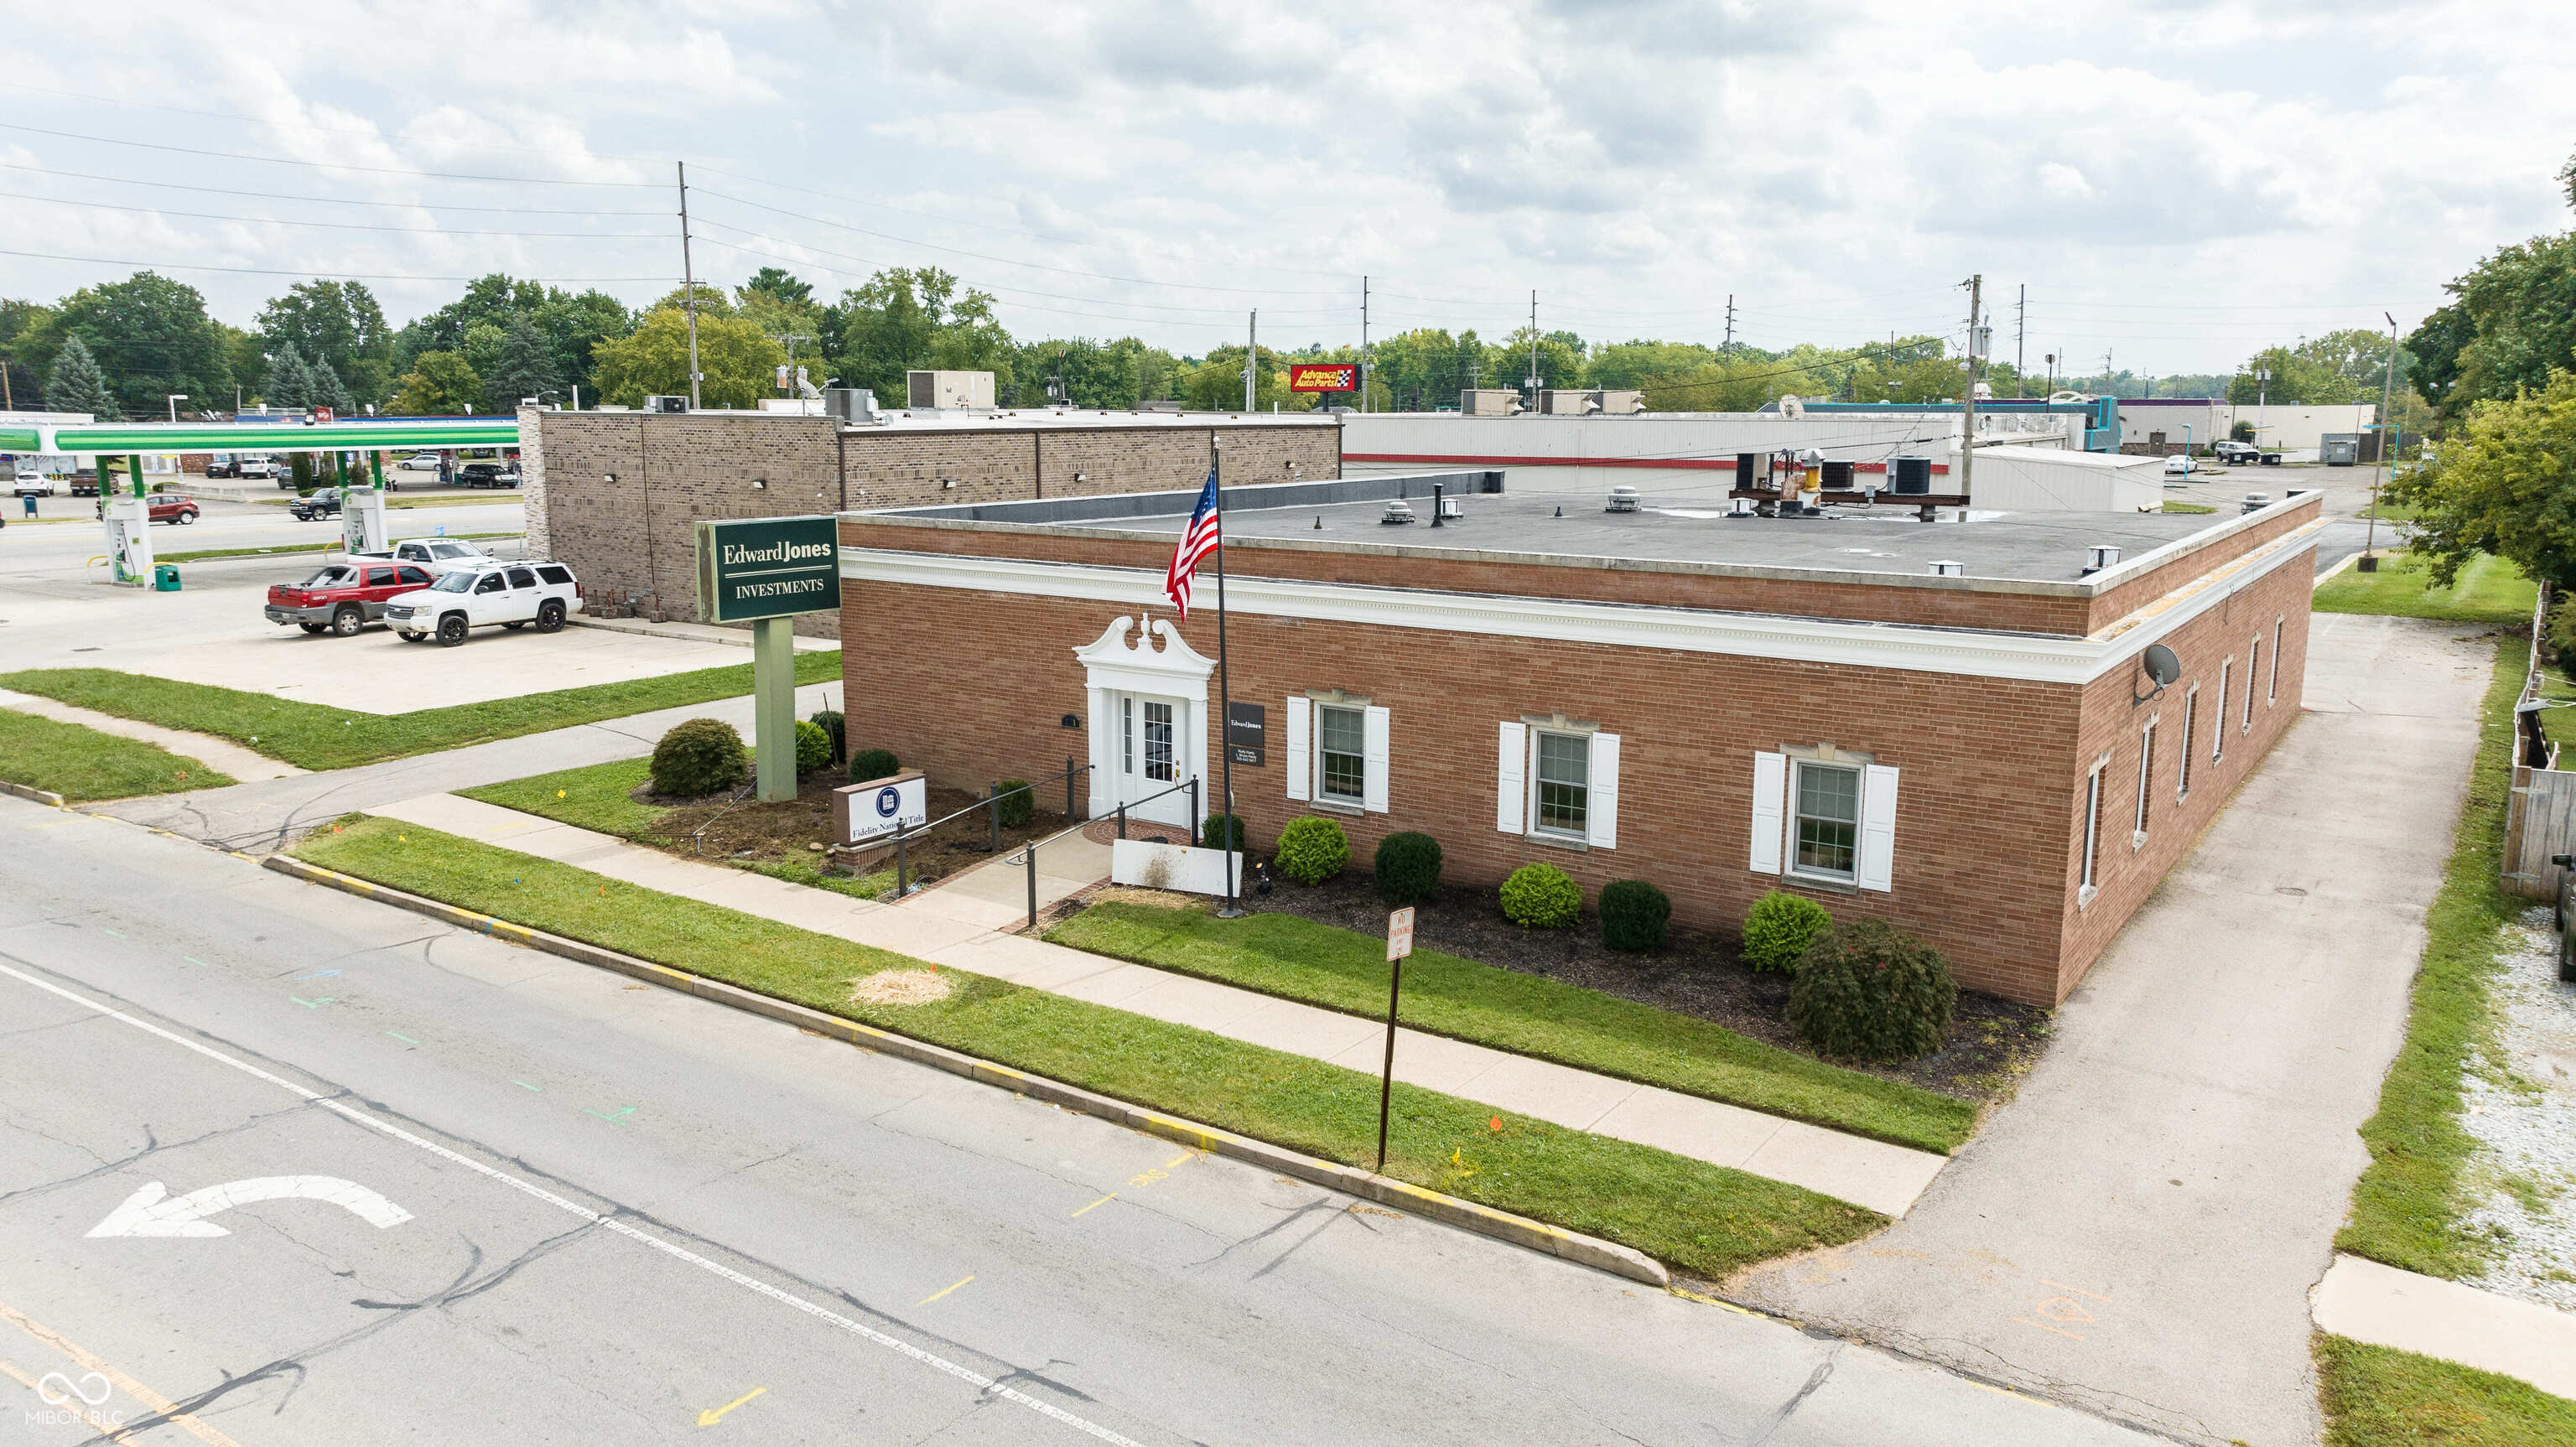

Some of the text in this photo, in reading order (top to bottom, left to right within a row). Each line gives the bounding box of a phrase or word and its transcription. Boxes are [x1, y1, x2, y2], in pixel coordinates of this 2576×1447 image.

[1300, 370, 1337, 379] Advance
[1295, 378, 1335, 387] Auto Parts
[735, 578, 824, 599] INVESTMENTS
[853, 814, 924, 838] Fidelity Natiol Title
[1397, 914, 1405, 926] NO
